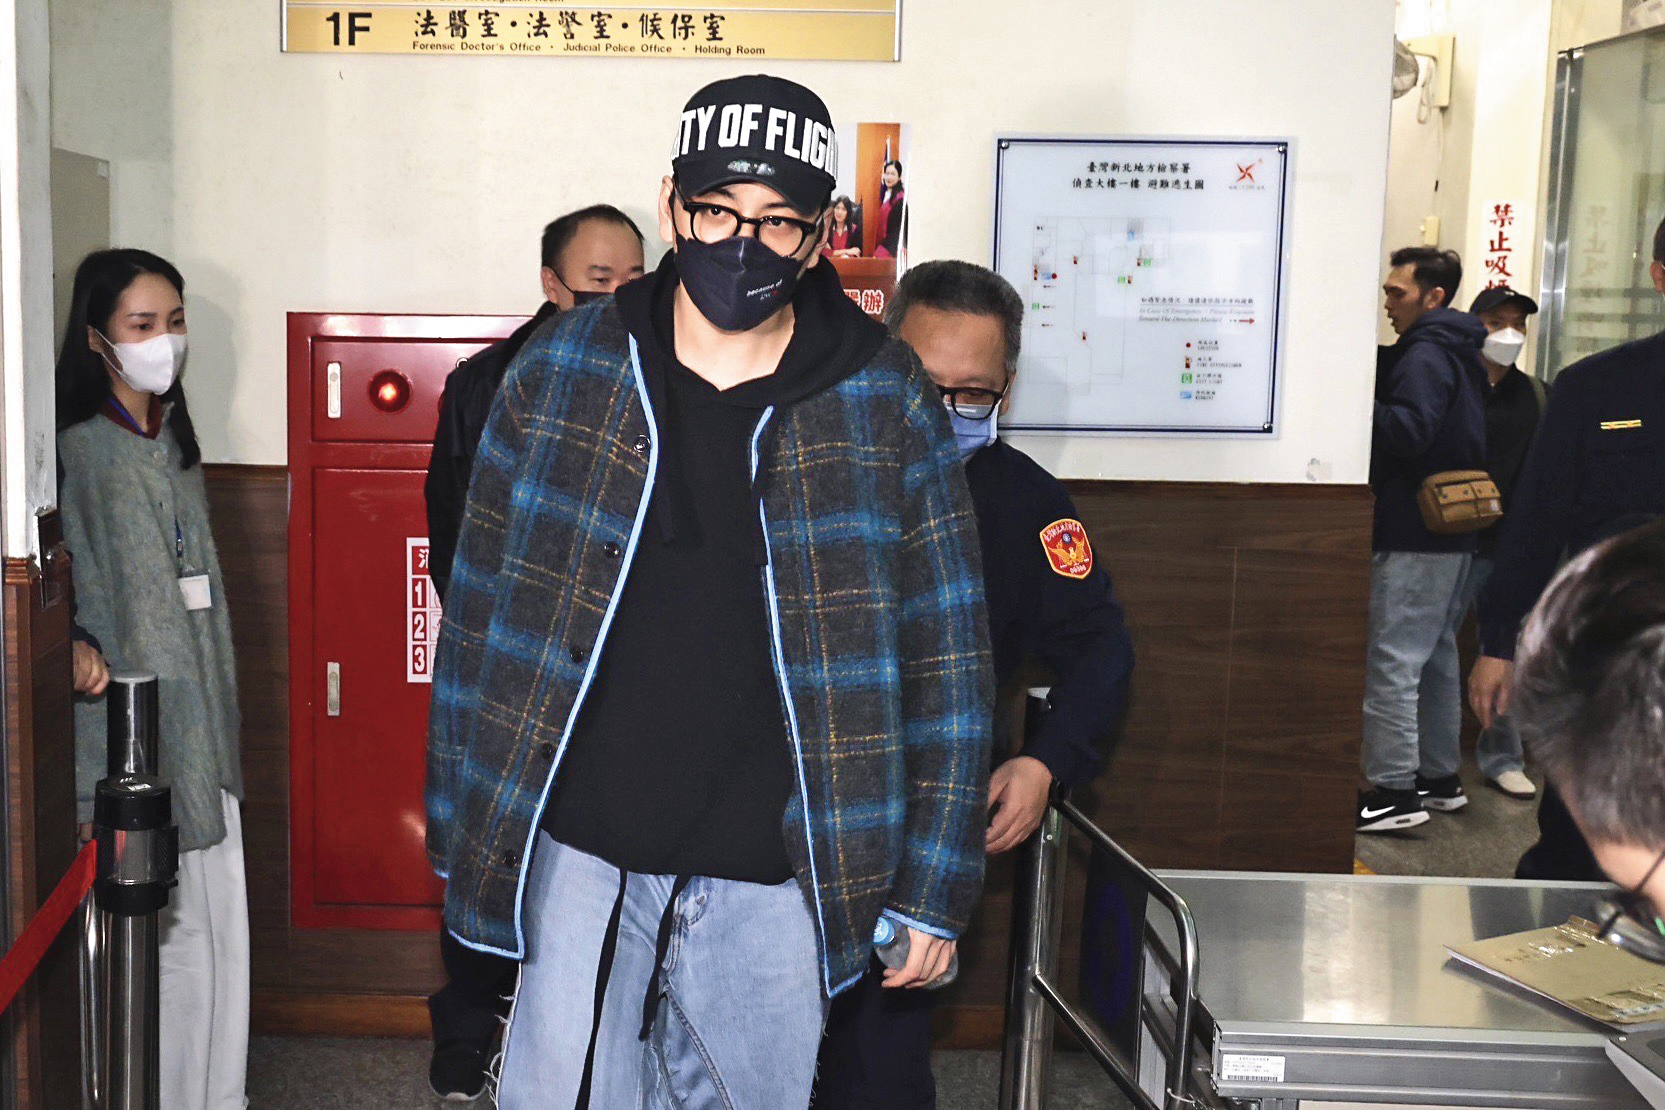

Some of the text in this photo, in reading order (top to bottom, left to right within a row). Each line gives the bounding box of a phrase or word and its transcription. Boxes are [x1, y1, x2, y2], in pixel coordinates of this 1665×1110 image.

[325, 11, 373, 46] 1F
[412, 41, 766, 56] Forensic Doctor's Office Judicial Police Office Holding Room
[718, 103, 763, 148] OF
[414, 580, 422, 606] 1
[413, 613, 425, 639] 2
[414, 646, 425, 672] 3
